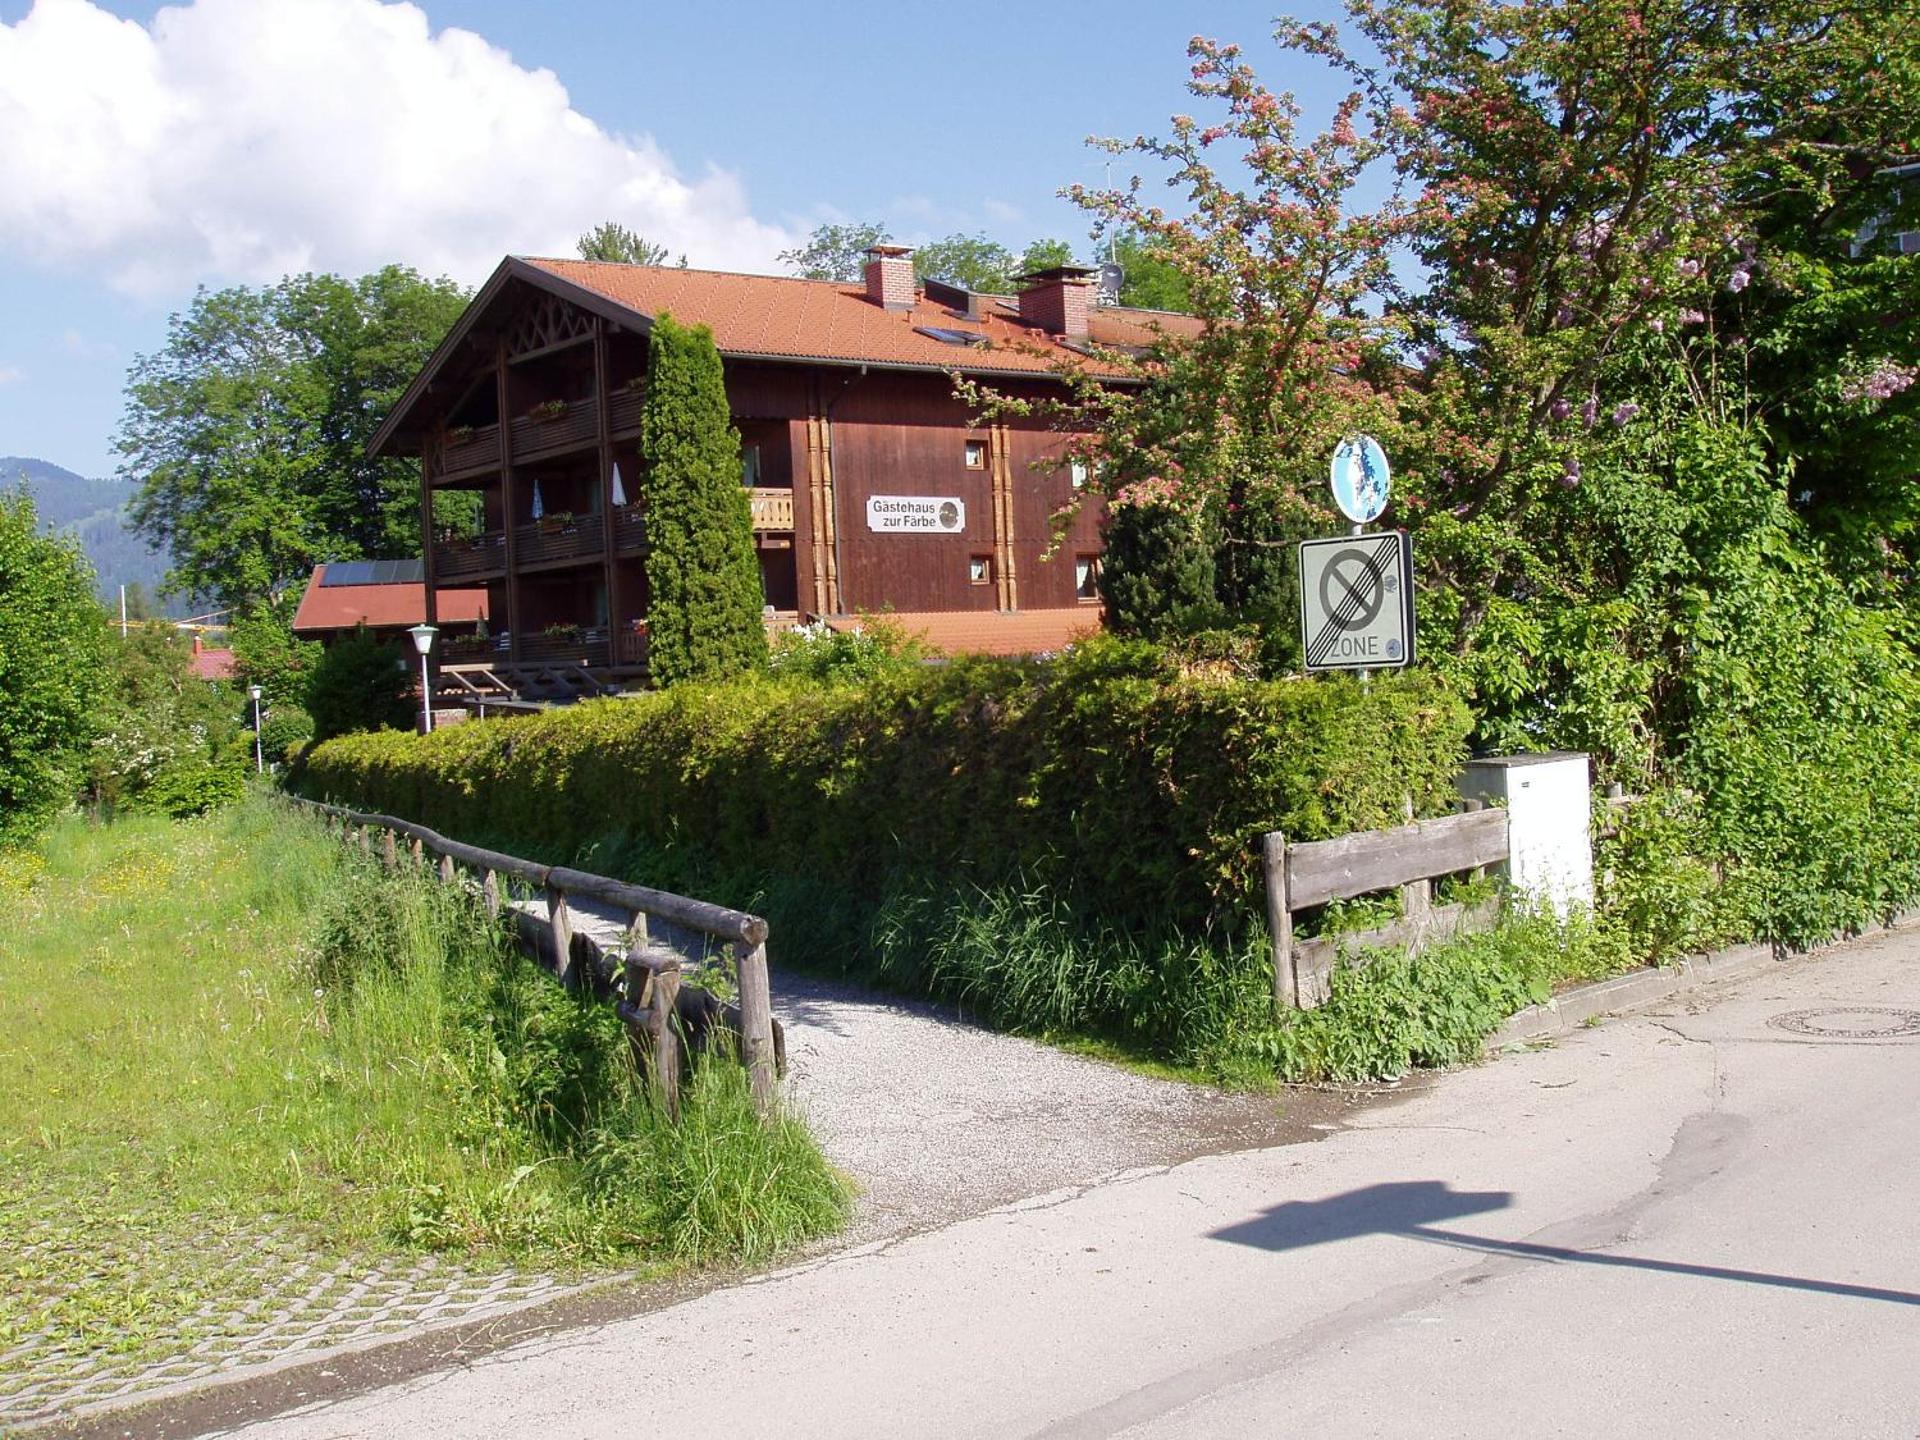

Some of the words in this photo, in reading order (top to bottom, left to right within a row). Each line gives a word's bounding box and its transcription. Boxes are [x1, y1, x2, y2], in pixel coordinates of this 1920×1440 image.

[873, 500, 935, 513] Gästehaus
[883, 517, 901, 527] zur
[904, 515, 936, 527] Färbe
[1331, 636, 1379, 657] ZONE
